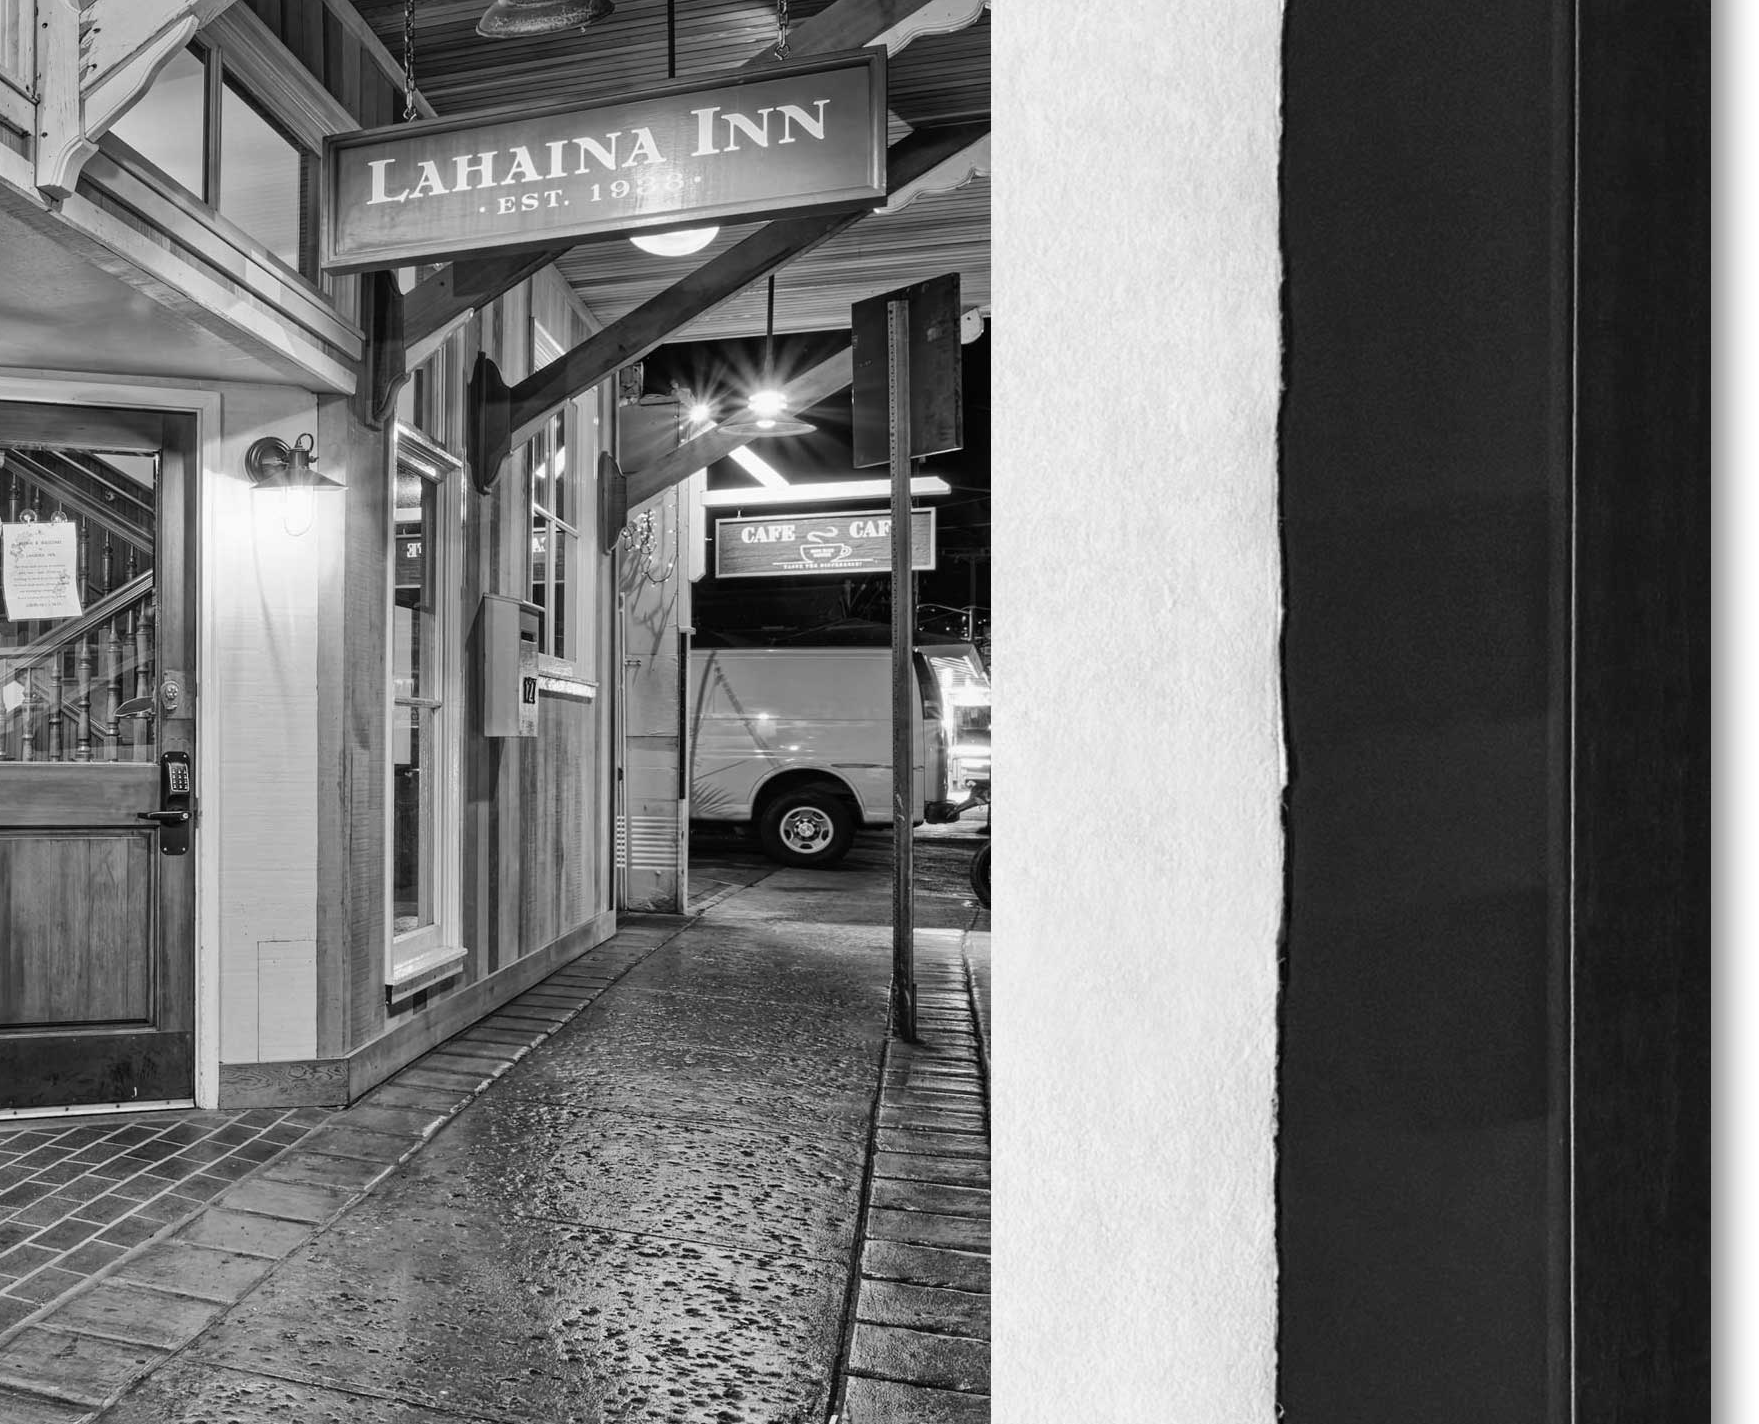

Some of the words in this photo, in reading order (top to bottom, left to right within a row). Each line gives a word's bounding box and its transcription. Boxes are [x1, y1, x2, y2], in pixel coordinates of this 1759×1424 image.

[365, 126, 667, 206] LAHAINA
[690, 99, 831, 157] INN
[496, 188, 571, 216] EST.
[741, 525, 796, 544] CAFE
[849, 519, 892, 539] CAF
